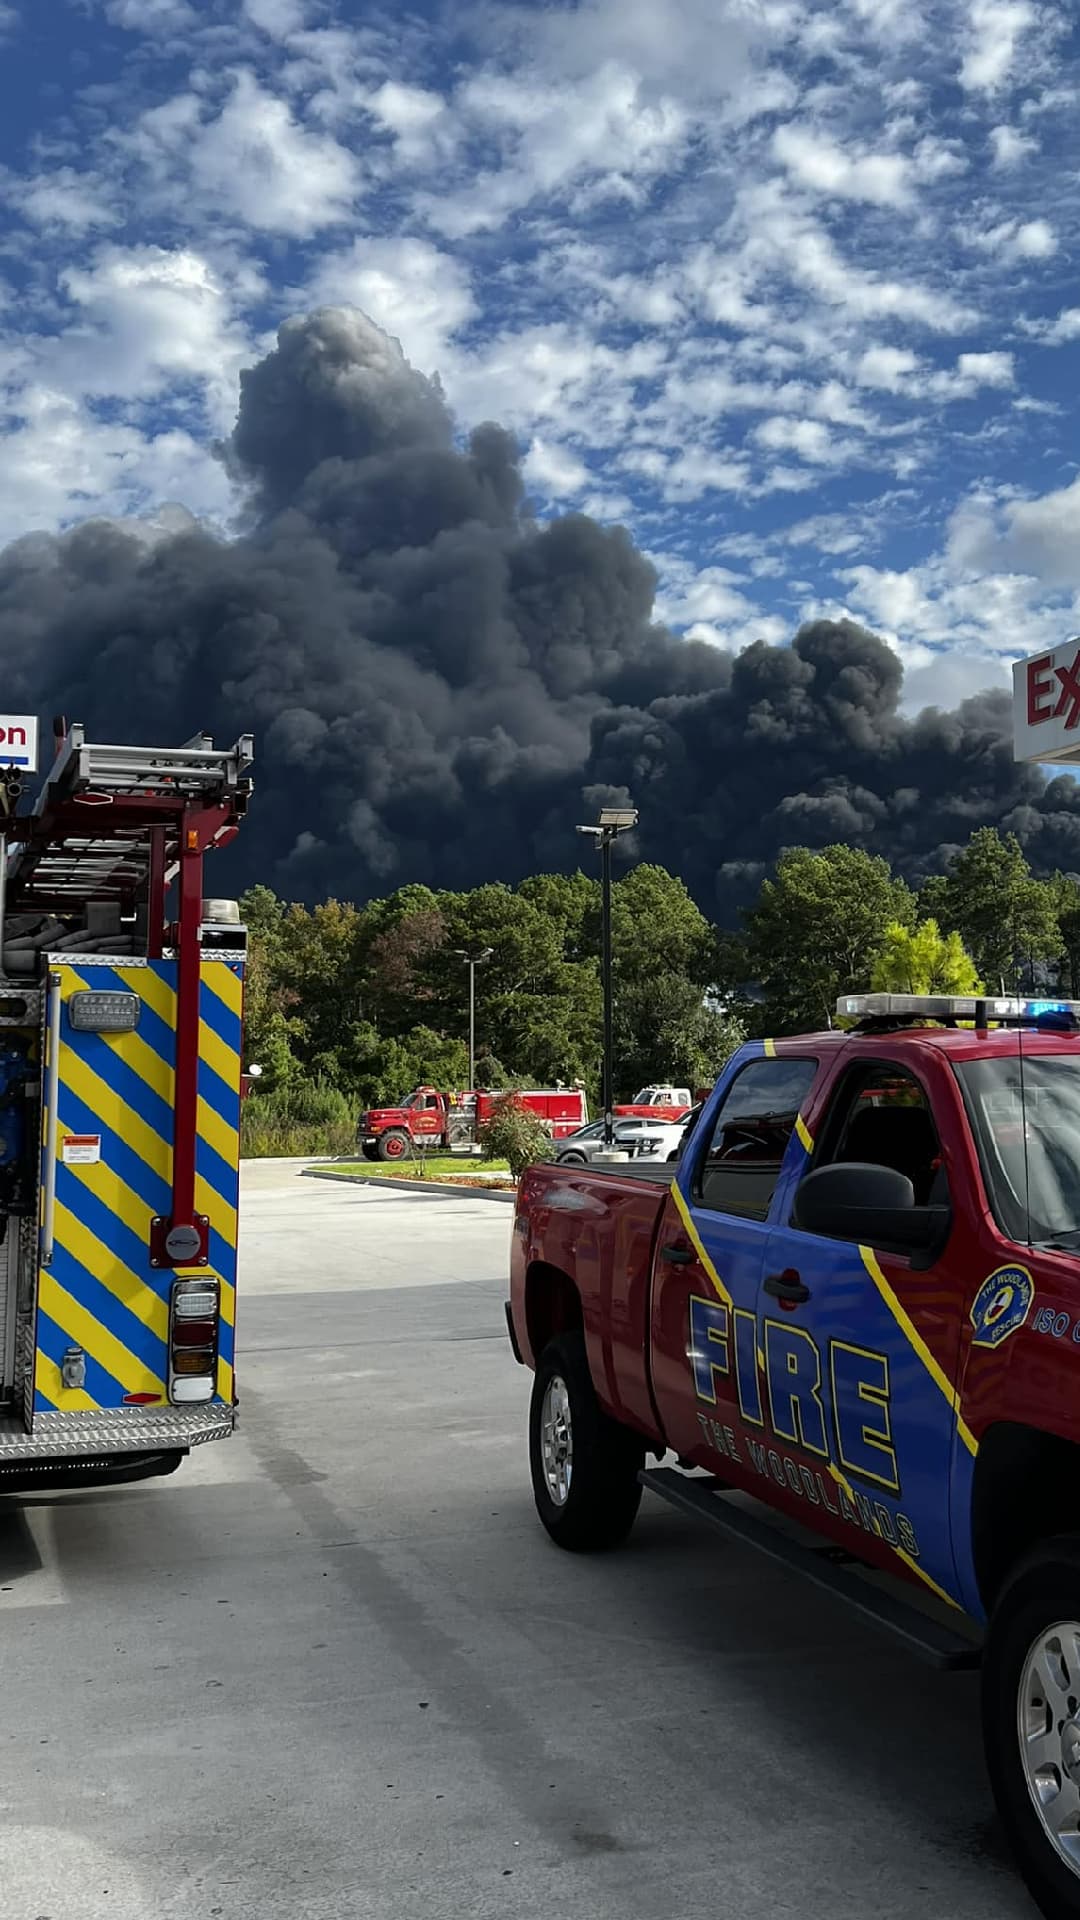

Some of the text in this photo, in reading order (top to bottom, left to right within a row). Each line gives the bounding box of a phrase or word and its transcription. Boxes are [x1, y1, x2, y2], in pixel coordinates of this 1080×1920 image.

[992, 1312, 1022, 1341] RESCUE
[1032, 1307, 1070, 1338] ISO
[689, 1293, 900, 1491] FIRE
[696, 1411, 920, 1557] THE WOODLANDS
